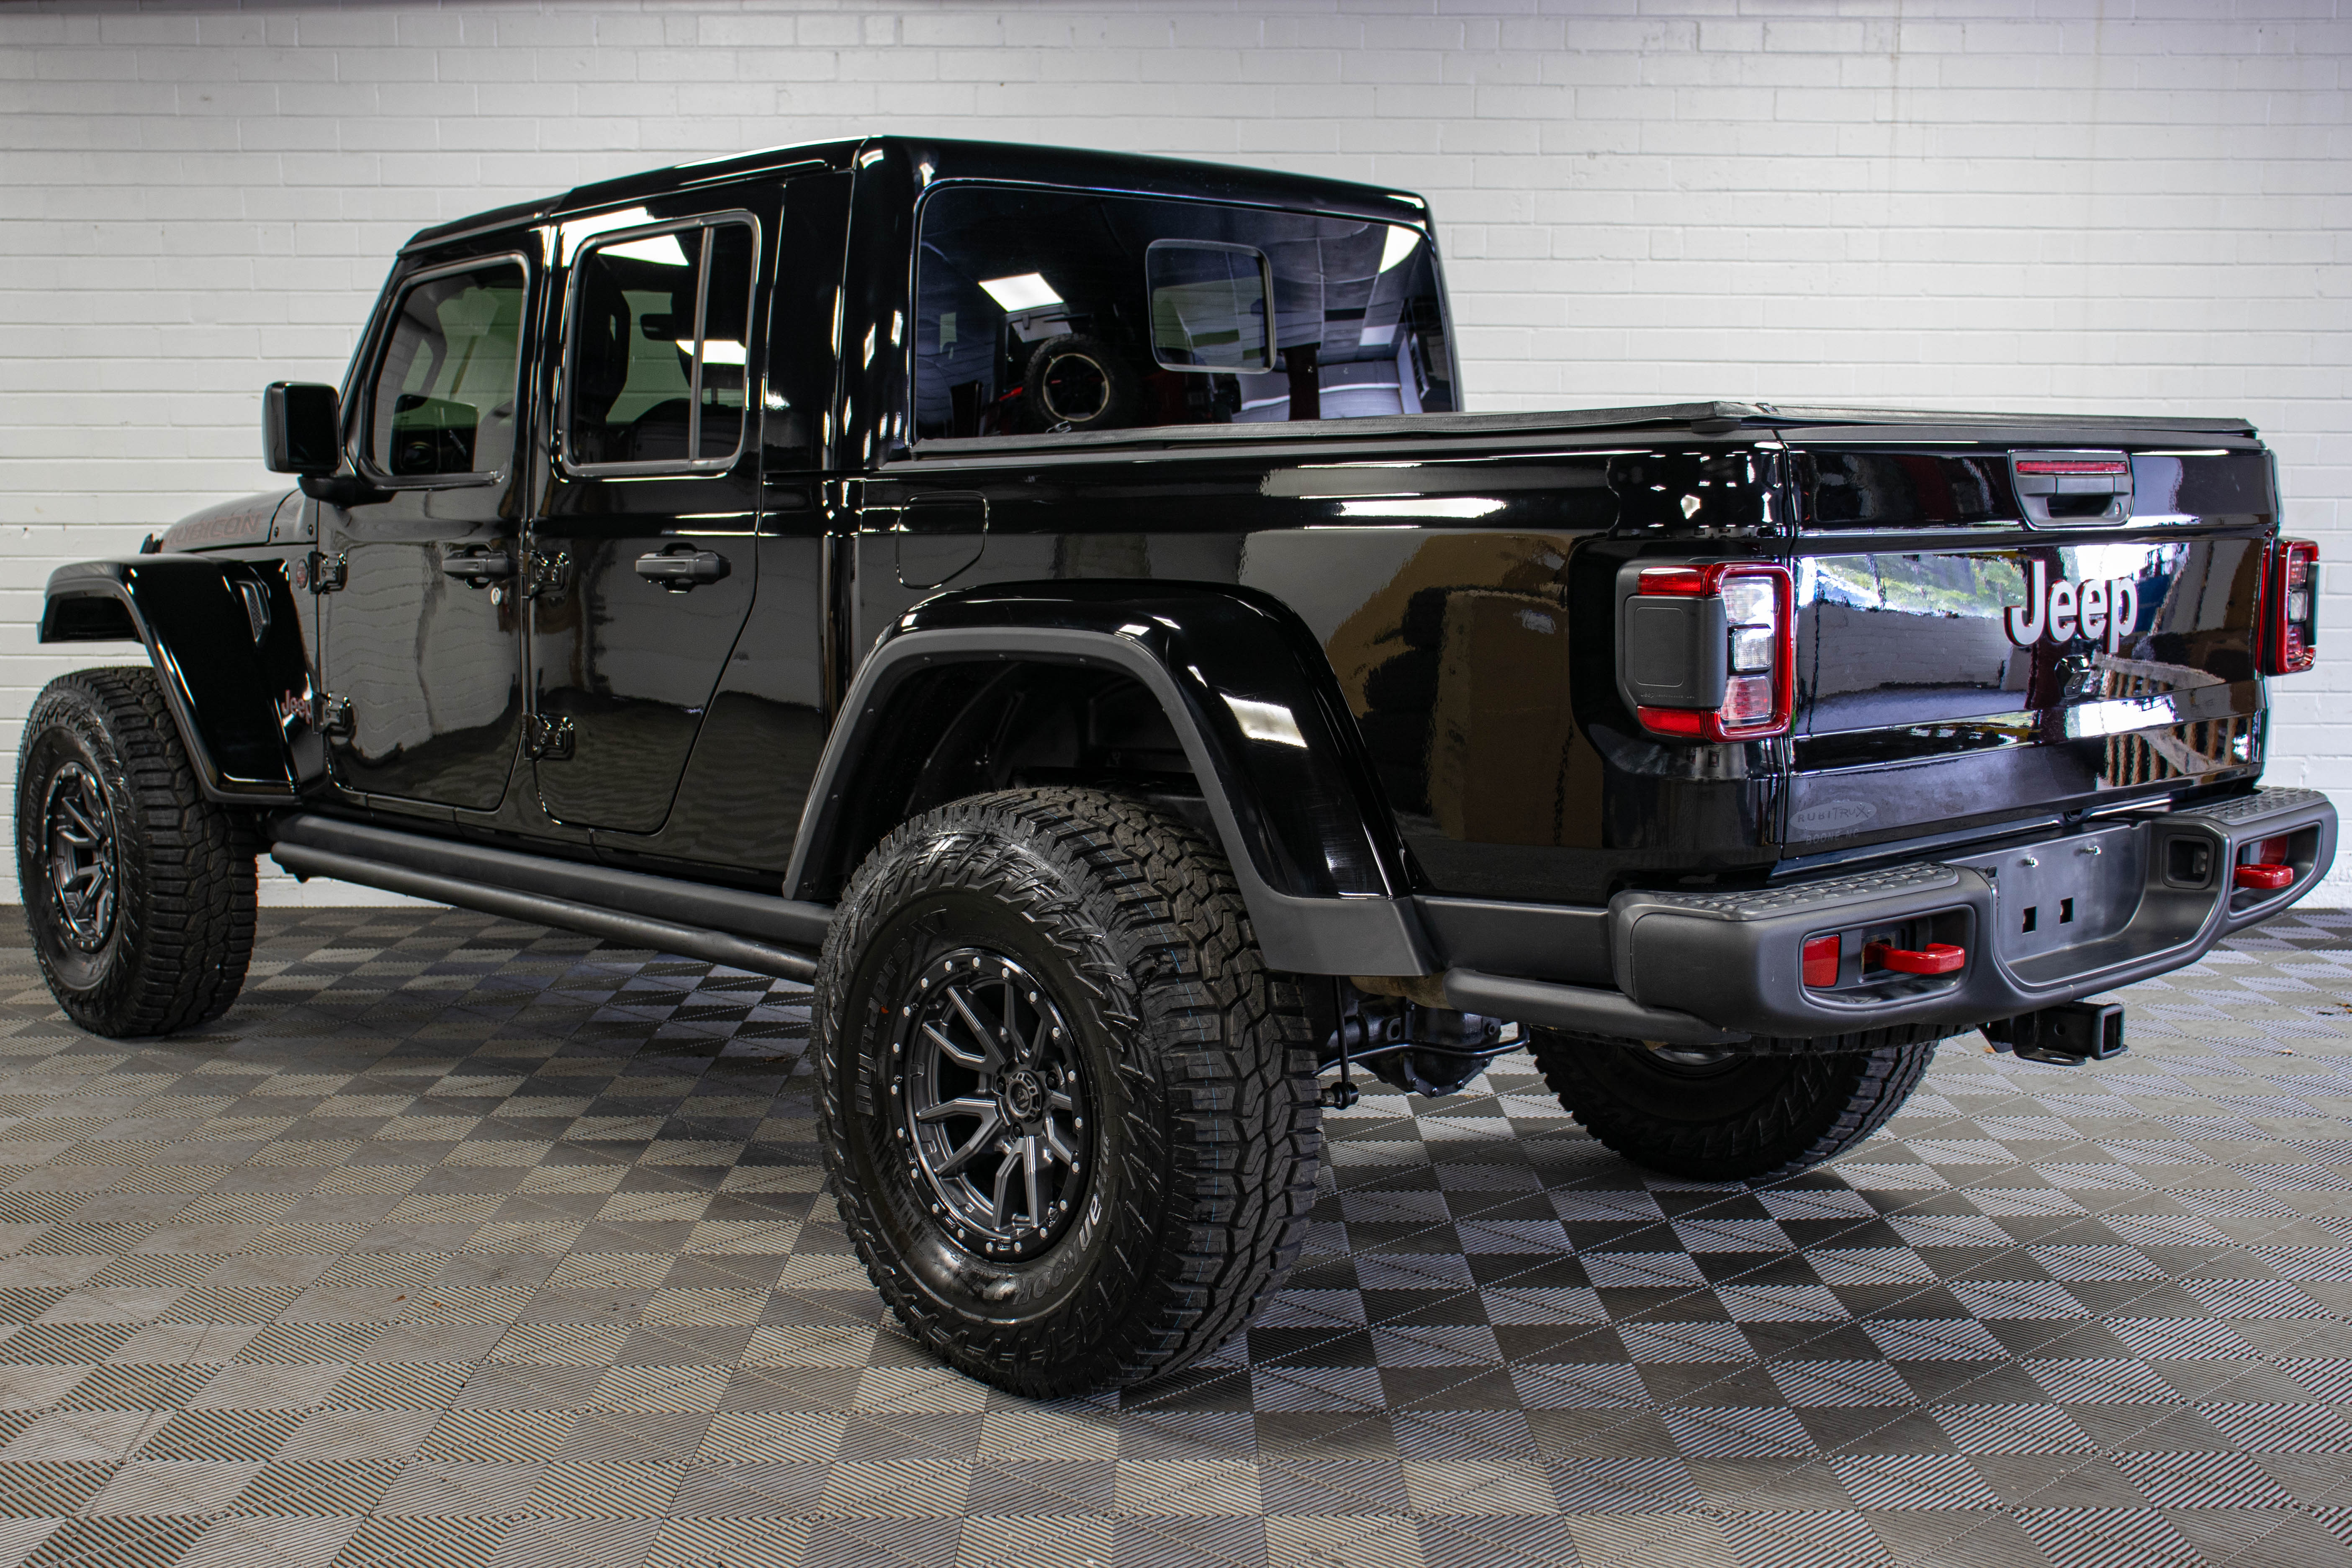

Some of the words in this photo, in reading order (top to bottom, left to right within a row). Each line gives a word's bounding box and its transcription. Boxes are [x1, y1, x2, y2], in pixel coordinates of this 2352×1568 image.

[2004, 560, 2138, 654] Jeep
[281, 690, 311, 724] Jeep
[1846, 828, 1859, 838] NC
